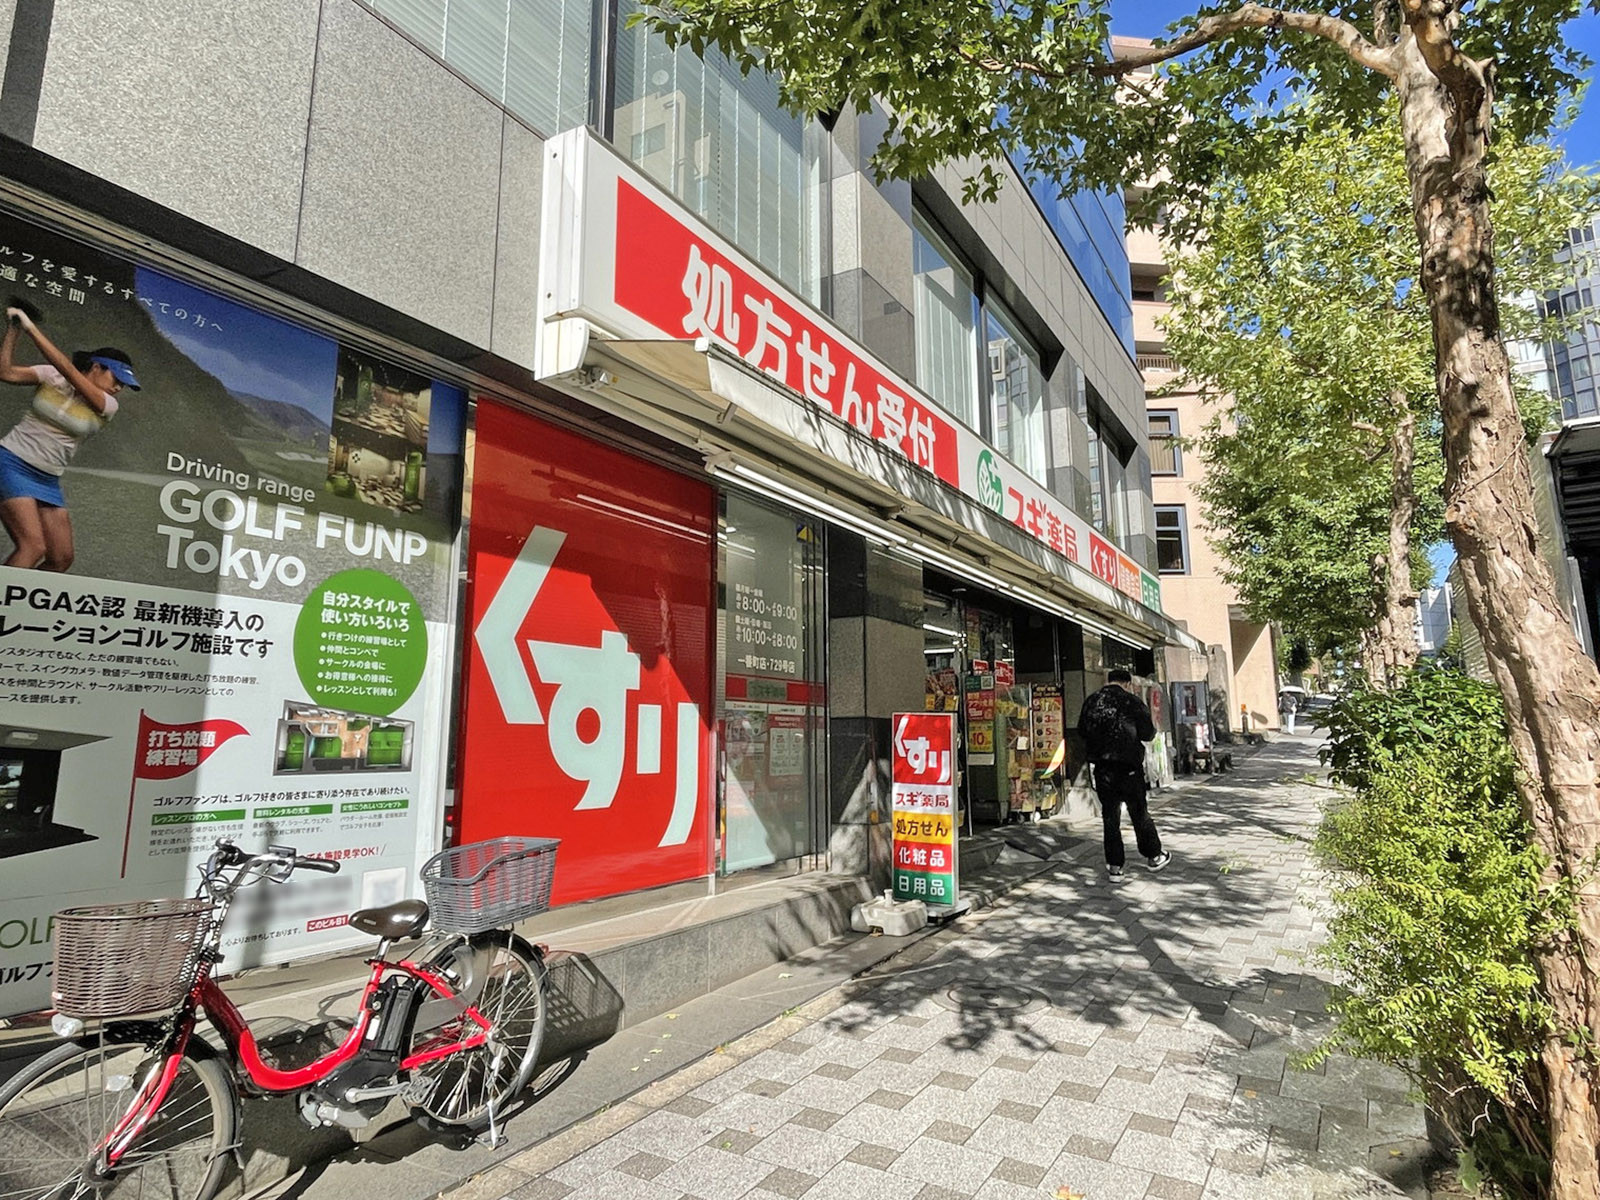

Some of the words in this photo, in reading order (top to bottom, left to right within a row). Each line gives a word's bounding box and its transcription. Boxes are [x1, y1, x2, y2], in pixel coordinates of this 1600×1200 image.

[681, 243, 936, 474] 処方せん受付
[166, 451, 250, 491] Driving
[256, 476, 316, 502] range
[159, 479, 305, 541] GOLF
[316, 511, 428, 565] FUNP
[1008, 486, 1078, 563] スギ薬局
[156, 523, 307, 591] Tokyo
[0, 585, 126, 619] PGA公認
[133, 599, 265, 632] 最新機導入の
[322, 590, 411, 616] 自分スタイルで
[320, 608, 410, 633] 使い方いろいろ
[474, 524, 699, 848] くすり
[148, 730, 217, 748] 打ち放題
[895, 717, 950, 783] くすり
[145, 748, 199, 767] 練習場
[895, 792, 950, 808] スギ薬局
[895, 818, 949, 838] 処方せん
[898, 846, 945, 868] 化粧品
[898, 875, 945, 897] 日用品
[308, 917, 347, 931] このビルB1
